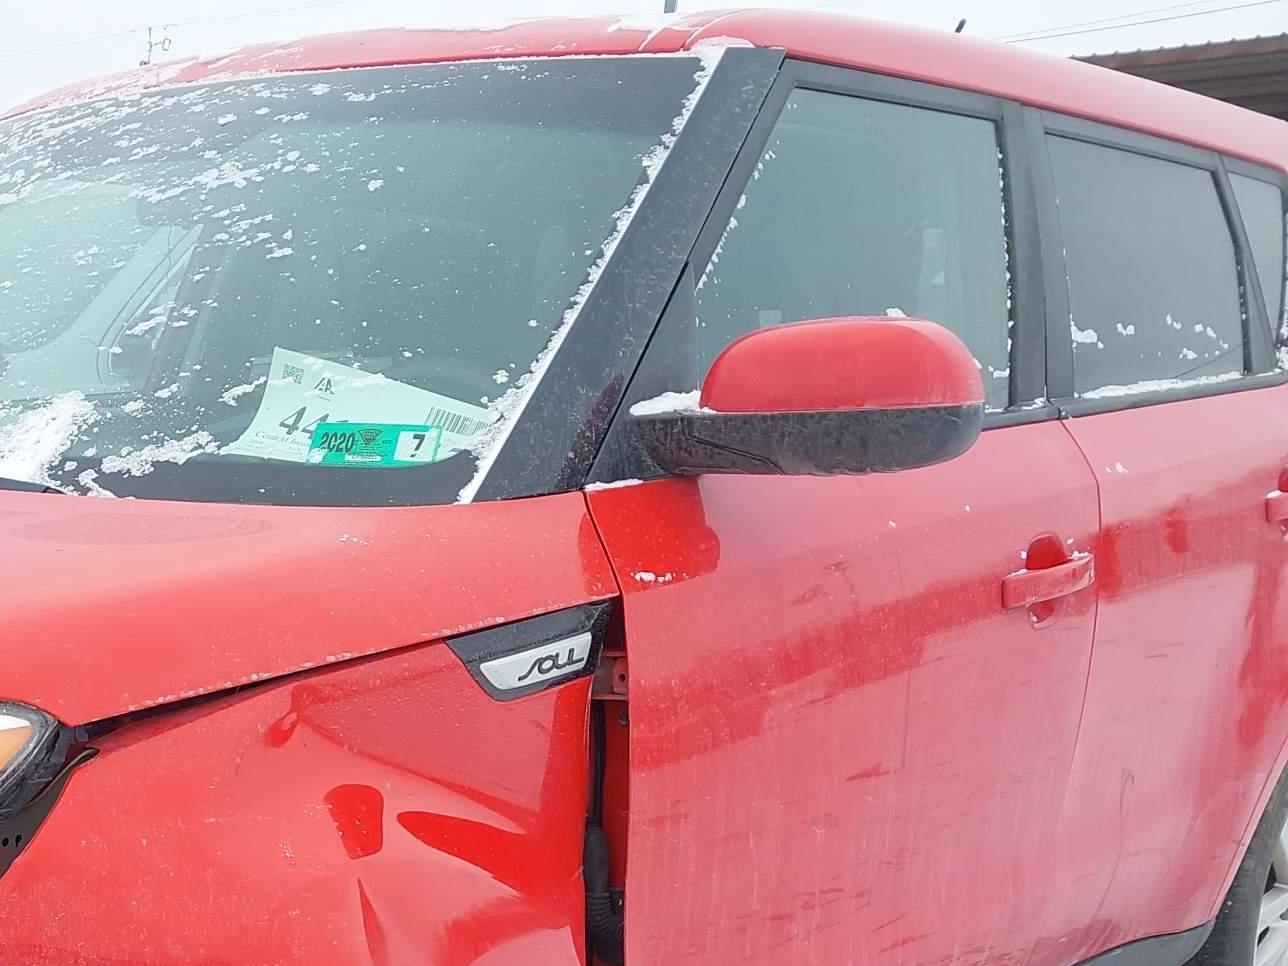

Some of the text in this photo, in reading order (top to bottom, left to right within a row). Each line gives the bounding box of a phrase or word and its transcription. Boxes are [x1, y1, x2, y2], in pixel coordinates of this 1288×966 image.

[320, 432, 355, 453] 2020
[409, 433, 426, 458] 7
[518, 648, 585, 681] SOUL
